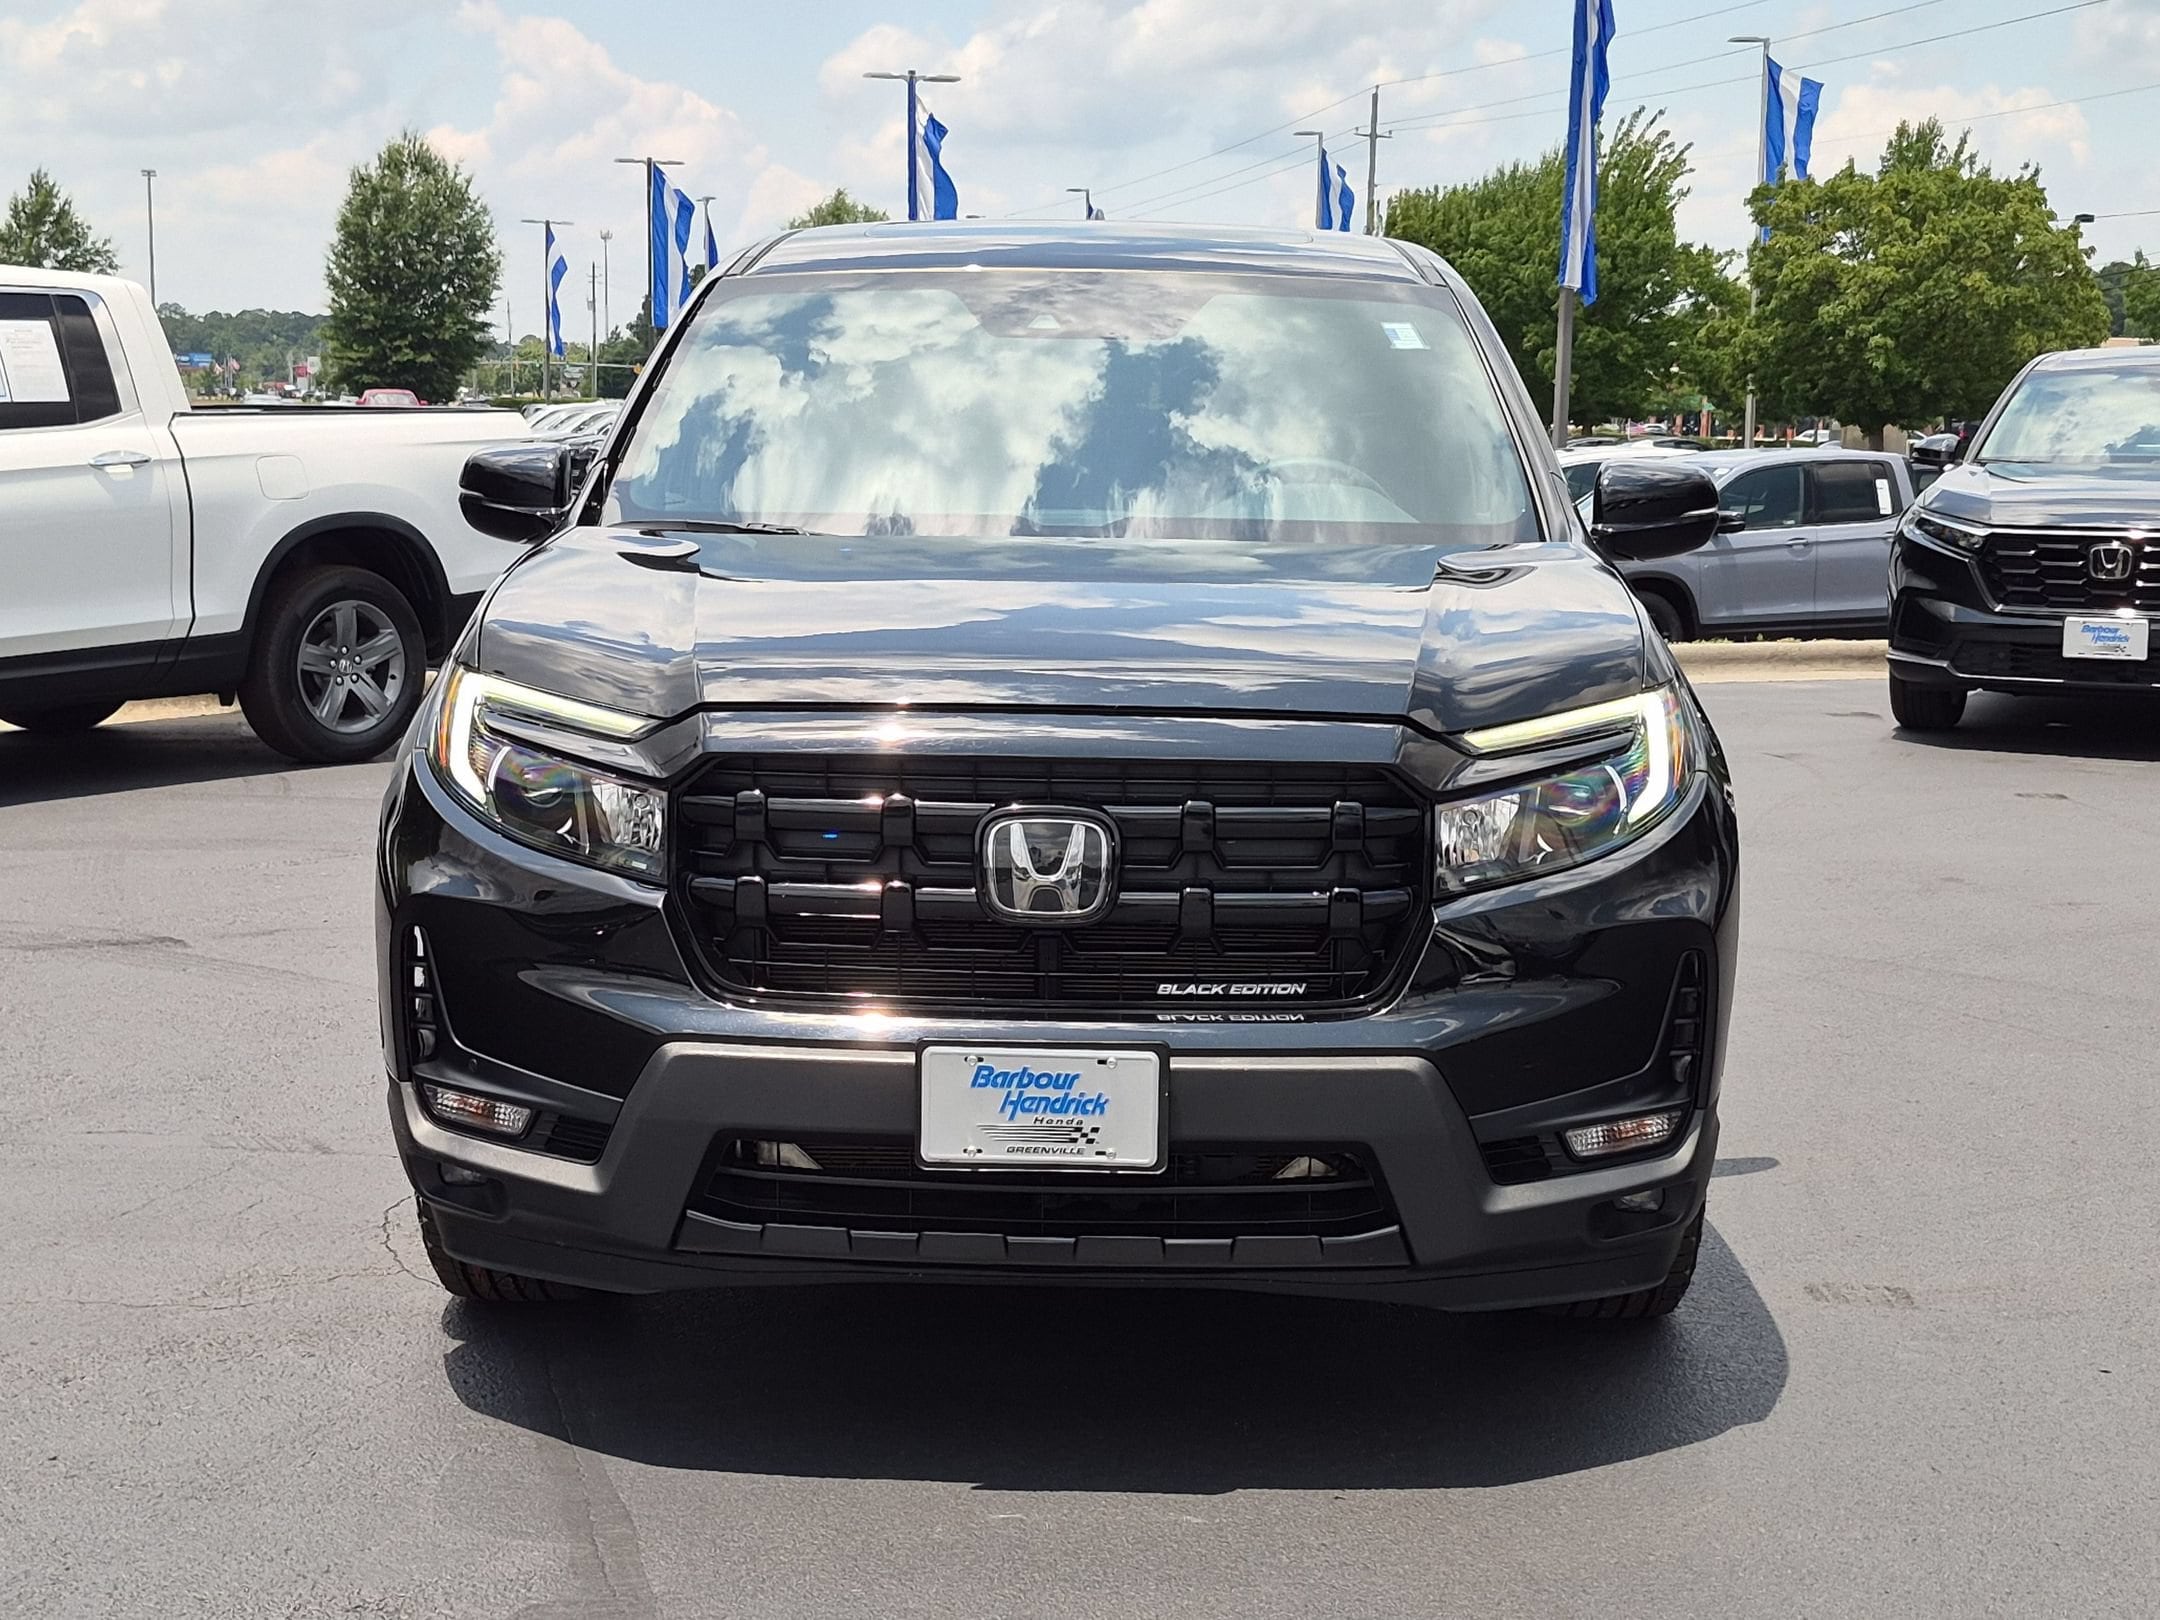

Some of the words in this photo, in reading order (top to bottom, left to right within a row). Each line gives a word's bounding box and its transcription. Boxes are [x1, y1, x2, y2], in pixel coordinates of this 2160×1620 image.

[1157, 983, 1227, 995] BLACK
[1229, 983, 1307, 995] EDITION
[970, 1064, 1082, 1090] Barbour
[999, 1090, 1109, 1121] Hendrick
[1033, 1116, 1084, 1126] Honda
[1006, 1146, 1086, 1155] GREENVILLE
